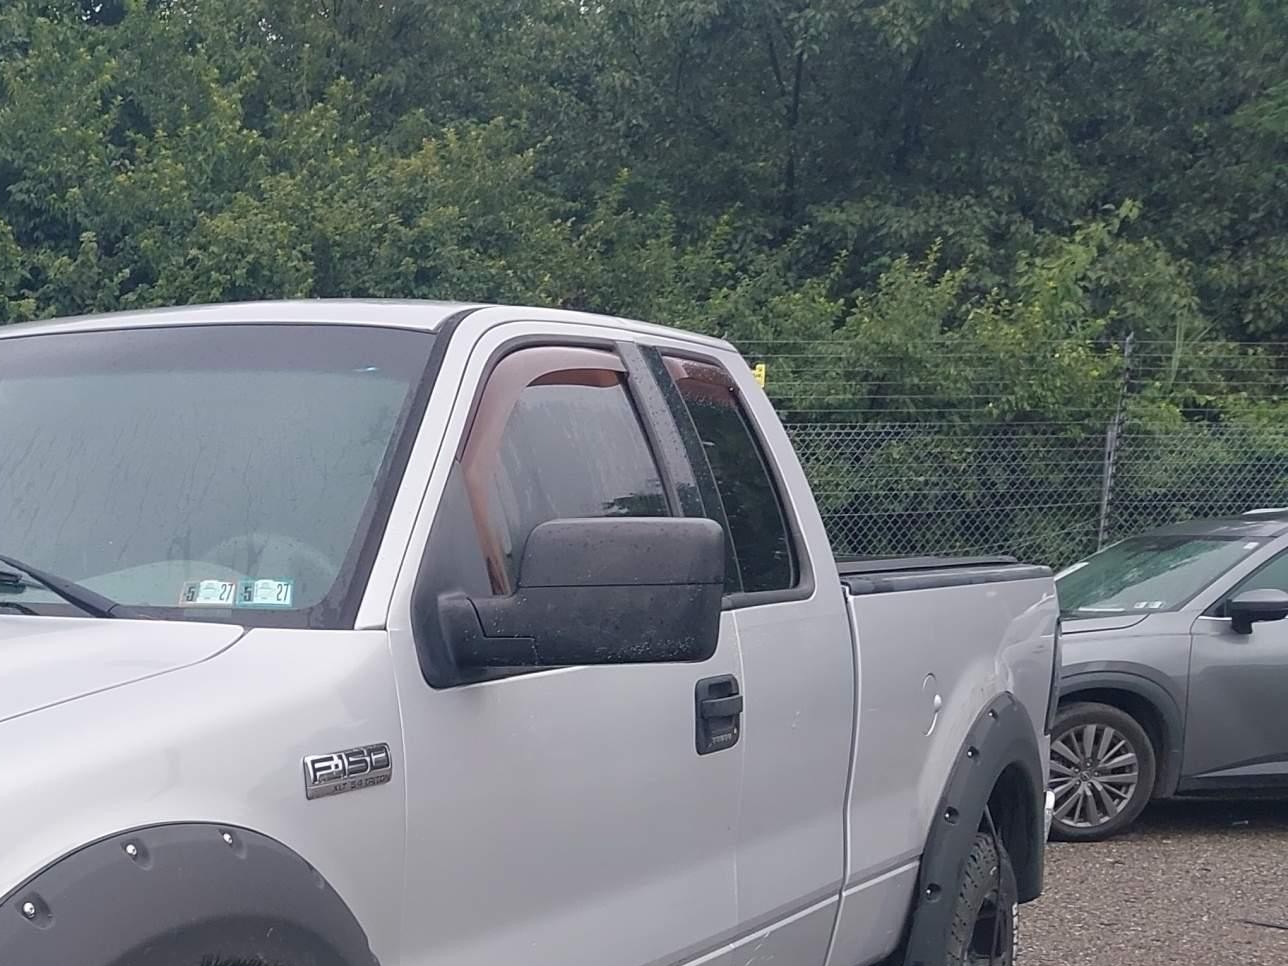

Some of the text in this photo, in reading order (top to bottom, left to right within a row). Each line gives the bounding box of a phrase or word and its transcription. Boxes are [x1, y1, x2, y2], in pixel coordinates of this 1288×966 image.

[186, 583, 233, 602] 5 27
[243, 583, 289, 602] 5 27
